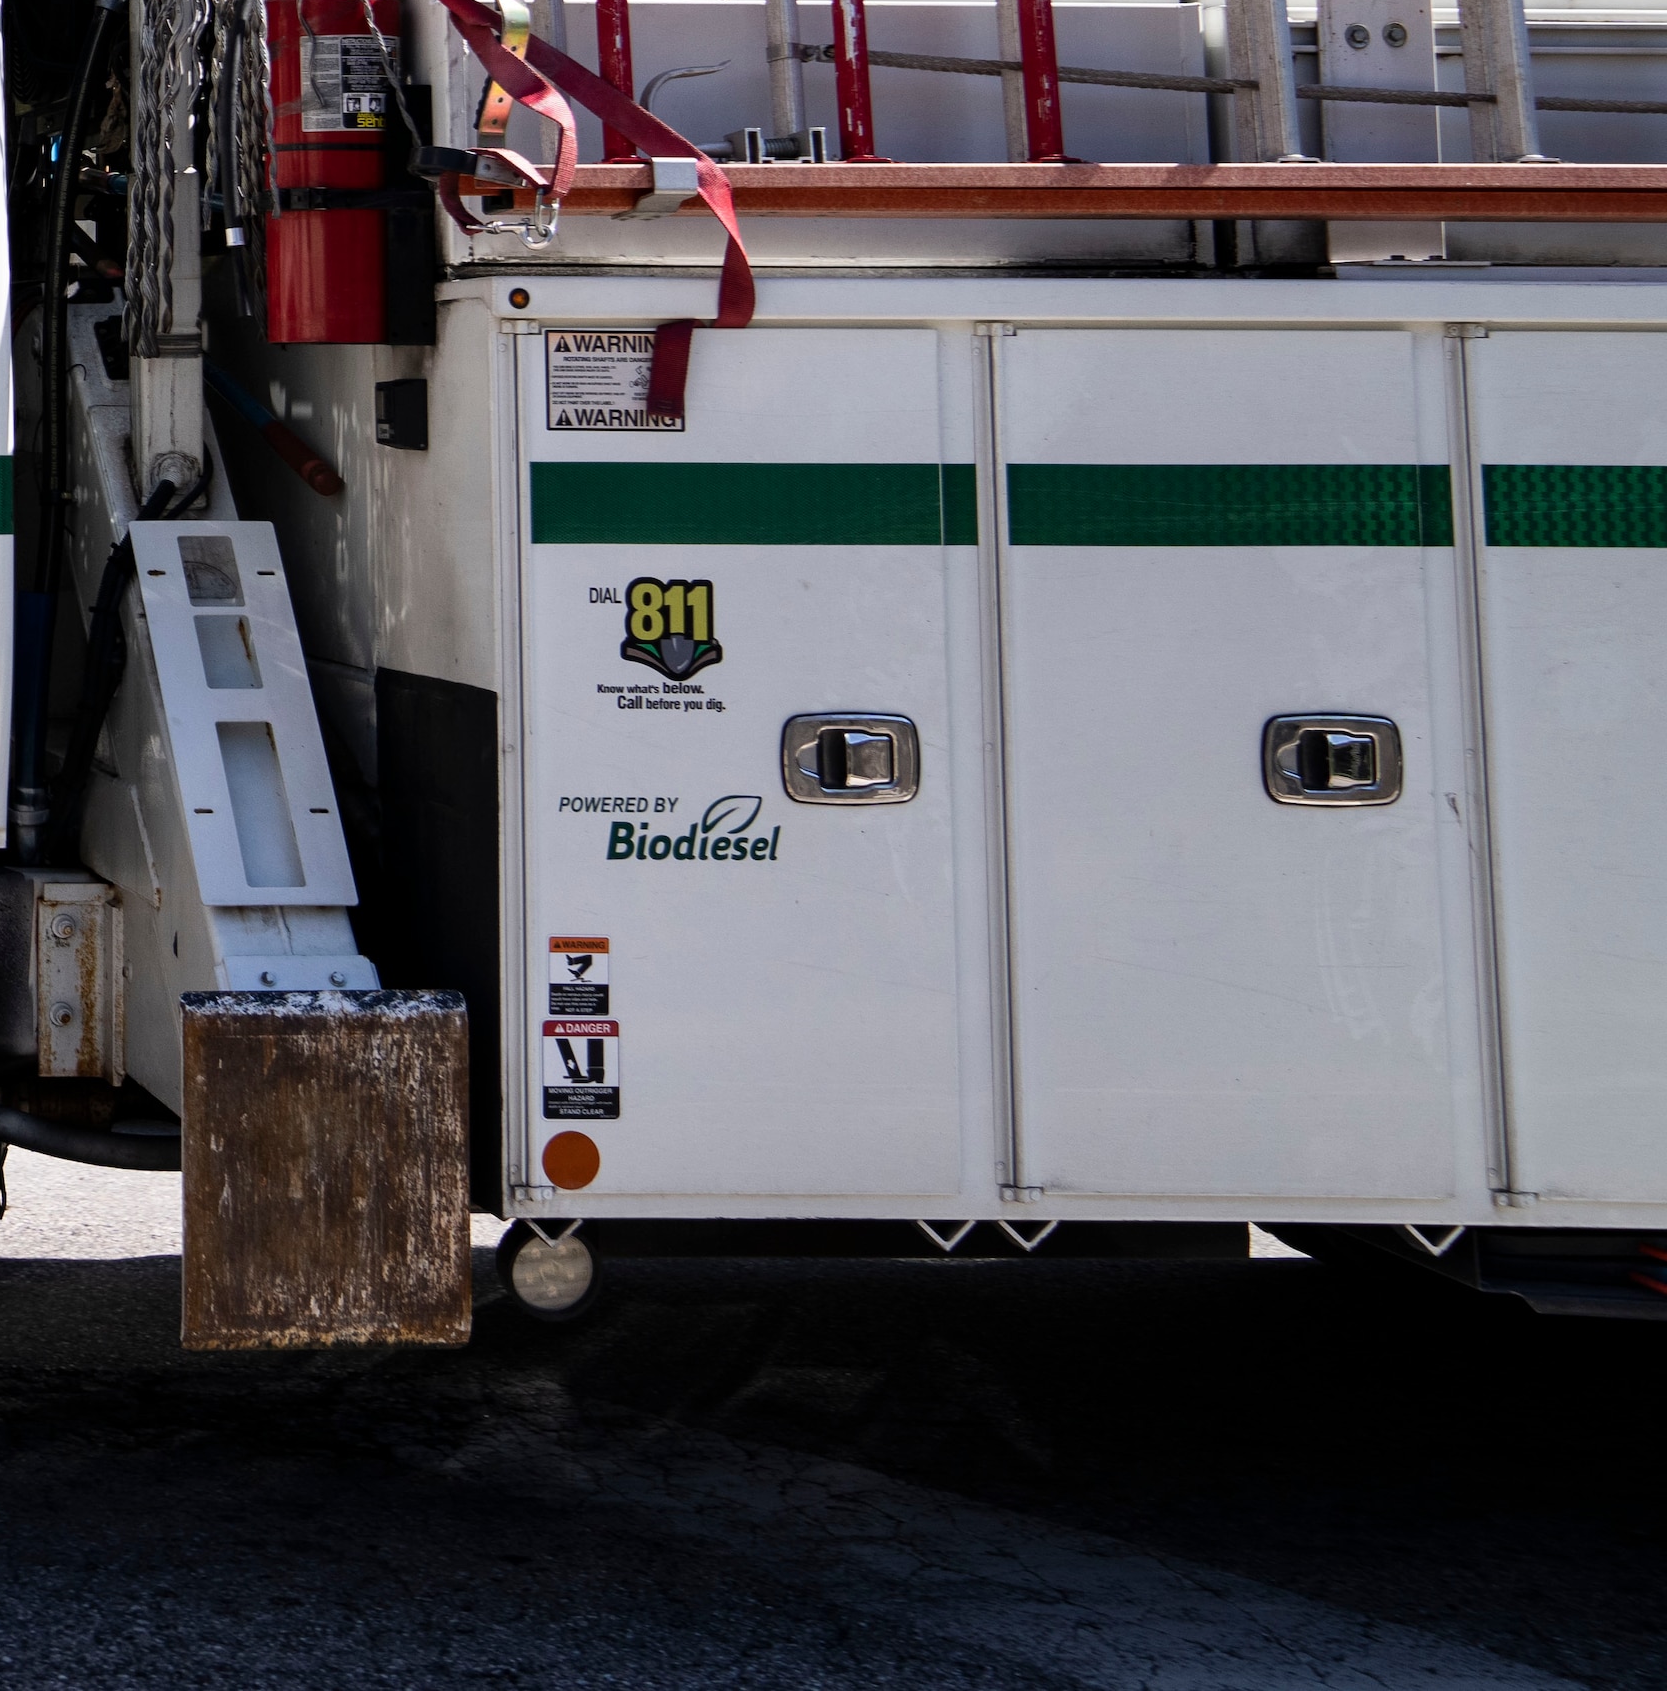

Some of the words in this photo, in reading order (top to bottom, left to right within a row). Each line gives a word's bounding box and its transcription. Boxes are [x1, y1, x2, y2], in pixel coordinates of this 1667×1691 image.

[573, 335, 655, 352] WARNIN
[574, 409, 676, 427] WARNING
[589, 588, 622, 604] DIAL
[630, 583, 709, 641] 811
[597, 684, 624, 693] Know
[627, 684, 660, 694] what's
[663, 682, 705, 694] below.
[617, 696, 643, 709] Call
[646, 698, 681, 709] before
[684, 700, 702, 712] you
[706, 698, 726, 712] dig.
[558, 797, 649, 812] POWERED
[653, 797, 679, 812] BY
[606, 821, 781, 860] Biodiesel
[562, 941, 605, 949] WARNING
[566, 1023, 611, 1033] DANGER
